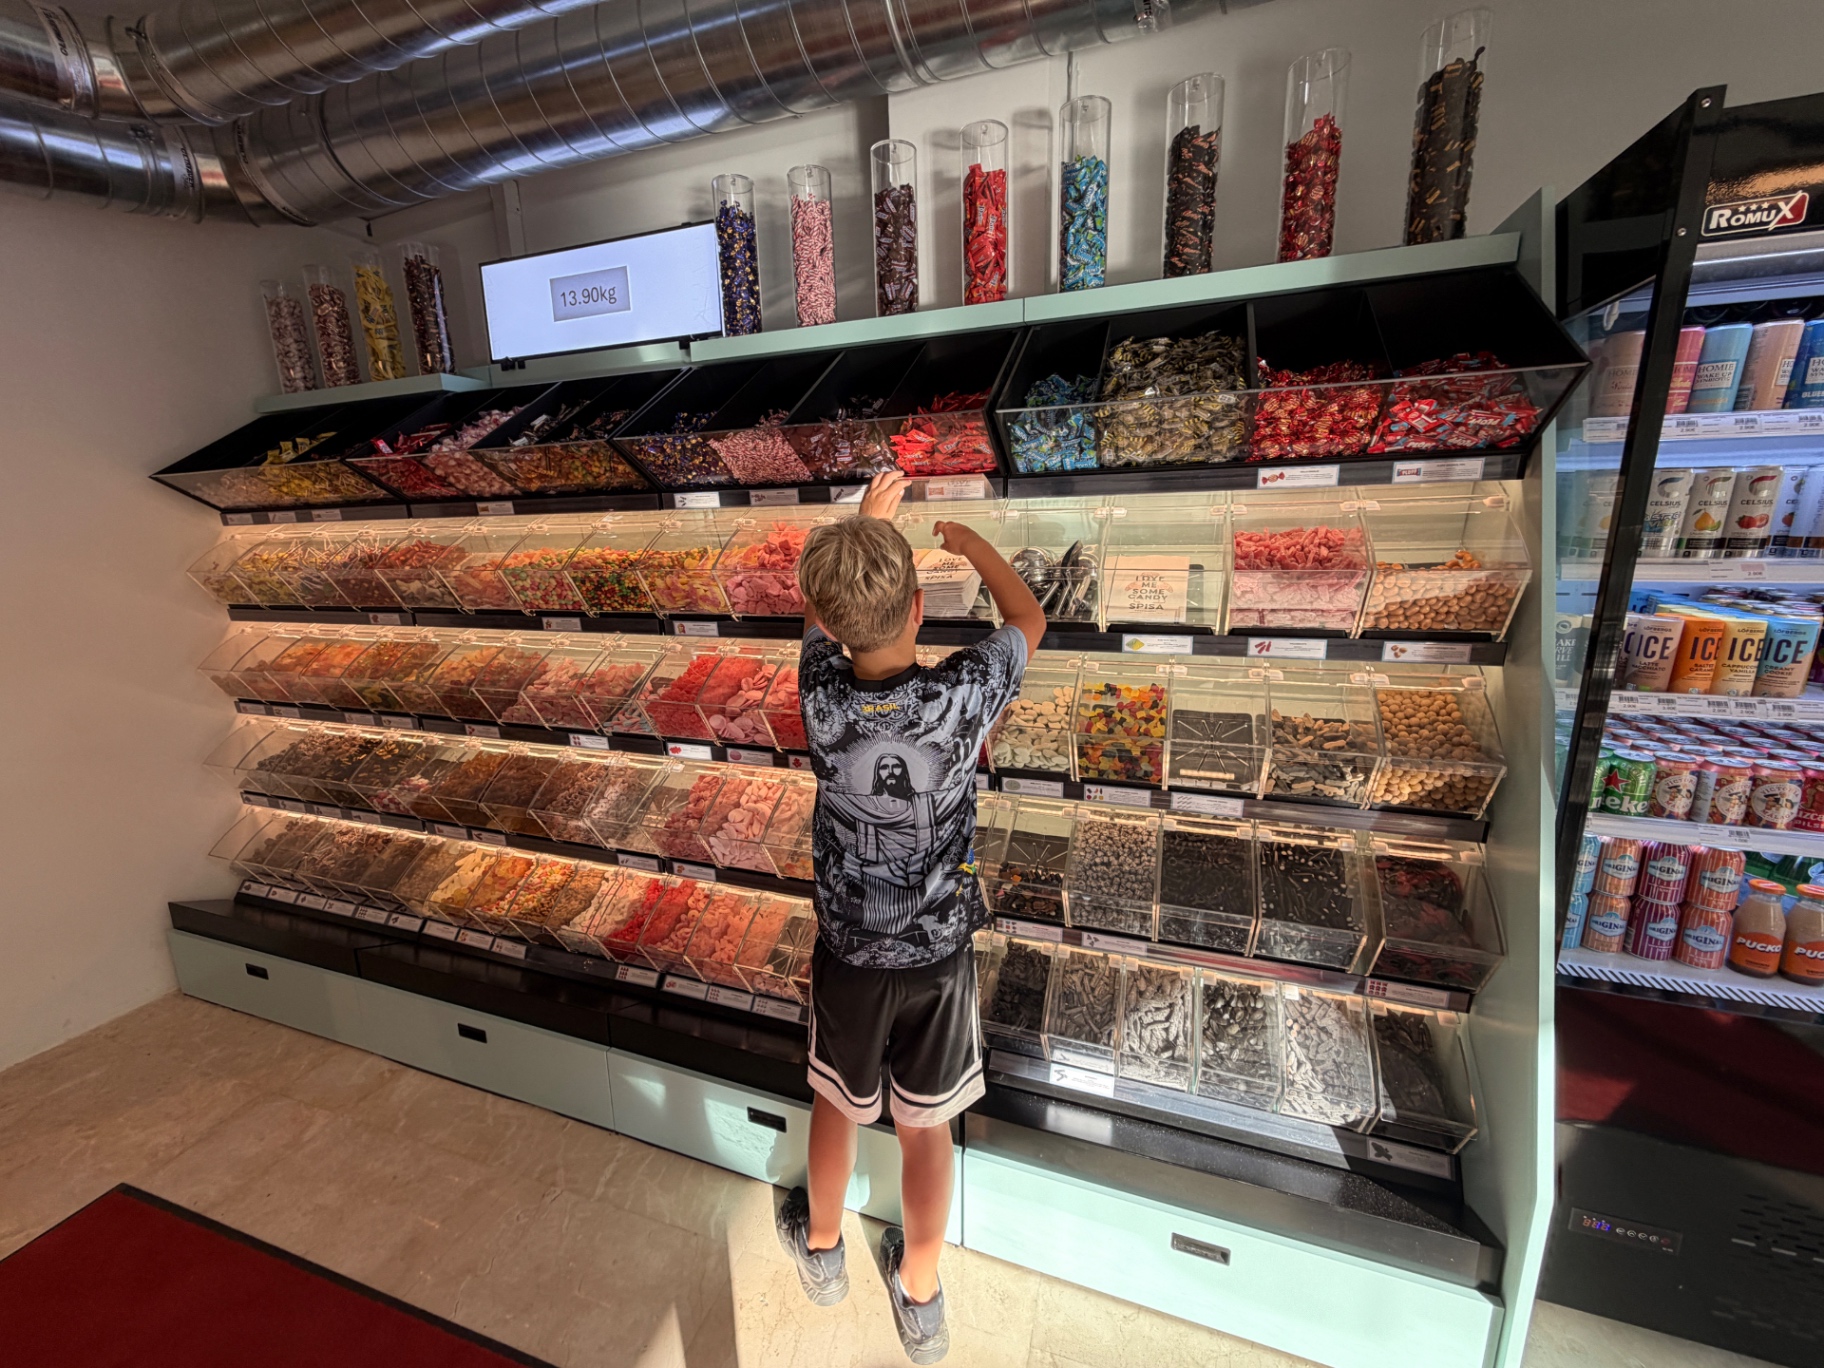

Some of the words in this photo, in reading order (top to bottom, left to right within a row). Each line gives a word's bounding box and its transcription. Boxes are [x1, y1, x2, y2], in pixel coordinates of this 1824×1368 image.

[560, 286, 616, 307] 13.90kg
[1697, 363, 1733, 373] HOMIE
[1128, 602, 1164, 611] SPISA
[1636, 635, 1673, 660] ICE
[1728, 638, 1764, 662] ICE
[1764, 638, 1808, 664] ICE
[860, 702, 899, 713] BRASIL
[1604, 863, 1636, 872] ORIGINAL
[1649, 863, 1683, 875] ORIGINAL
[1591, 919, 1625, 930] ORIGINAL
[1684, 933, 1722, 945] ORIGINAL
[1736, 936, 1782, 953] PUCKO
